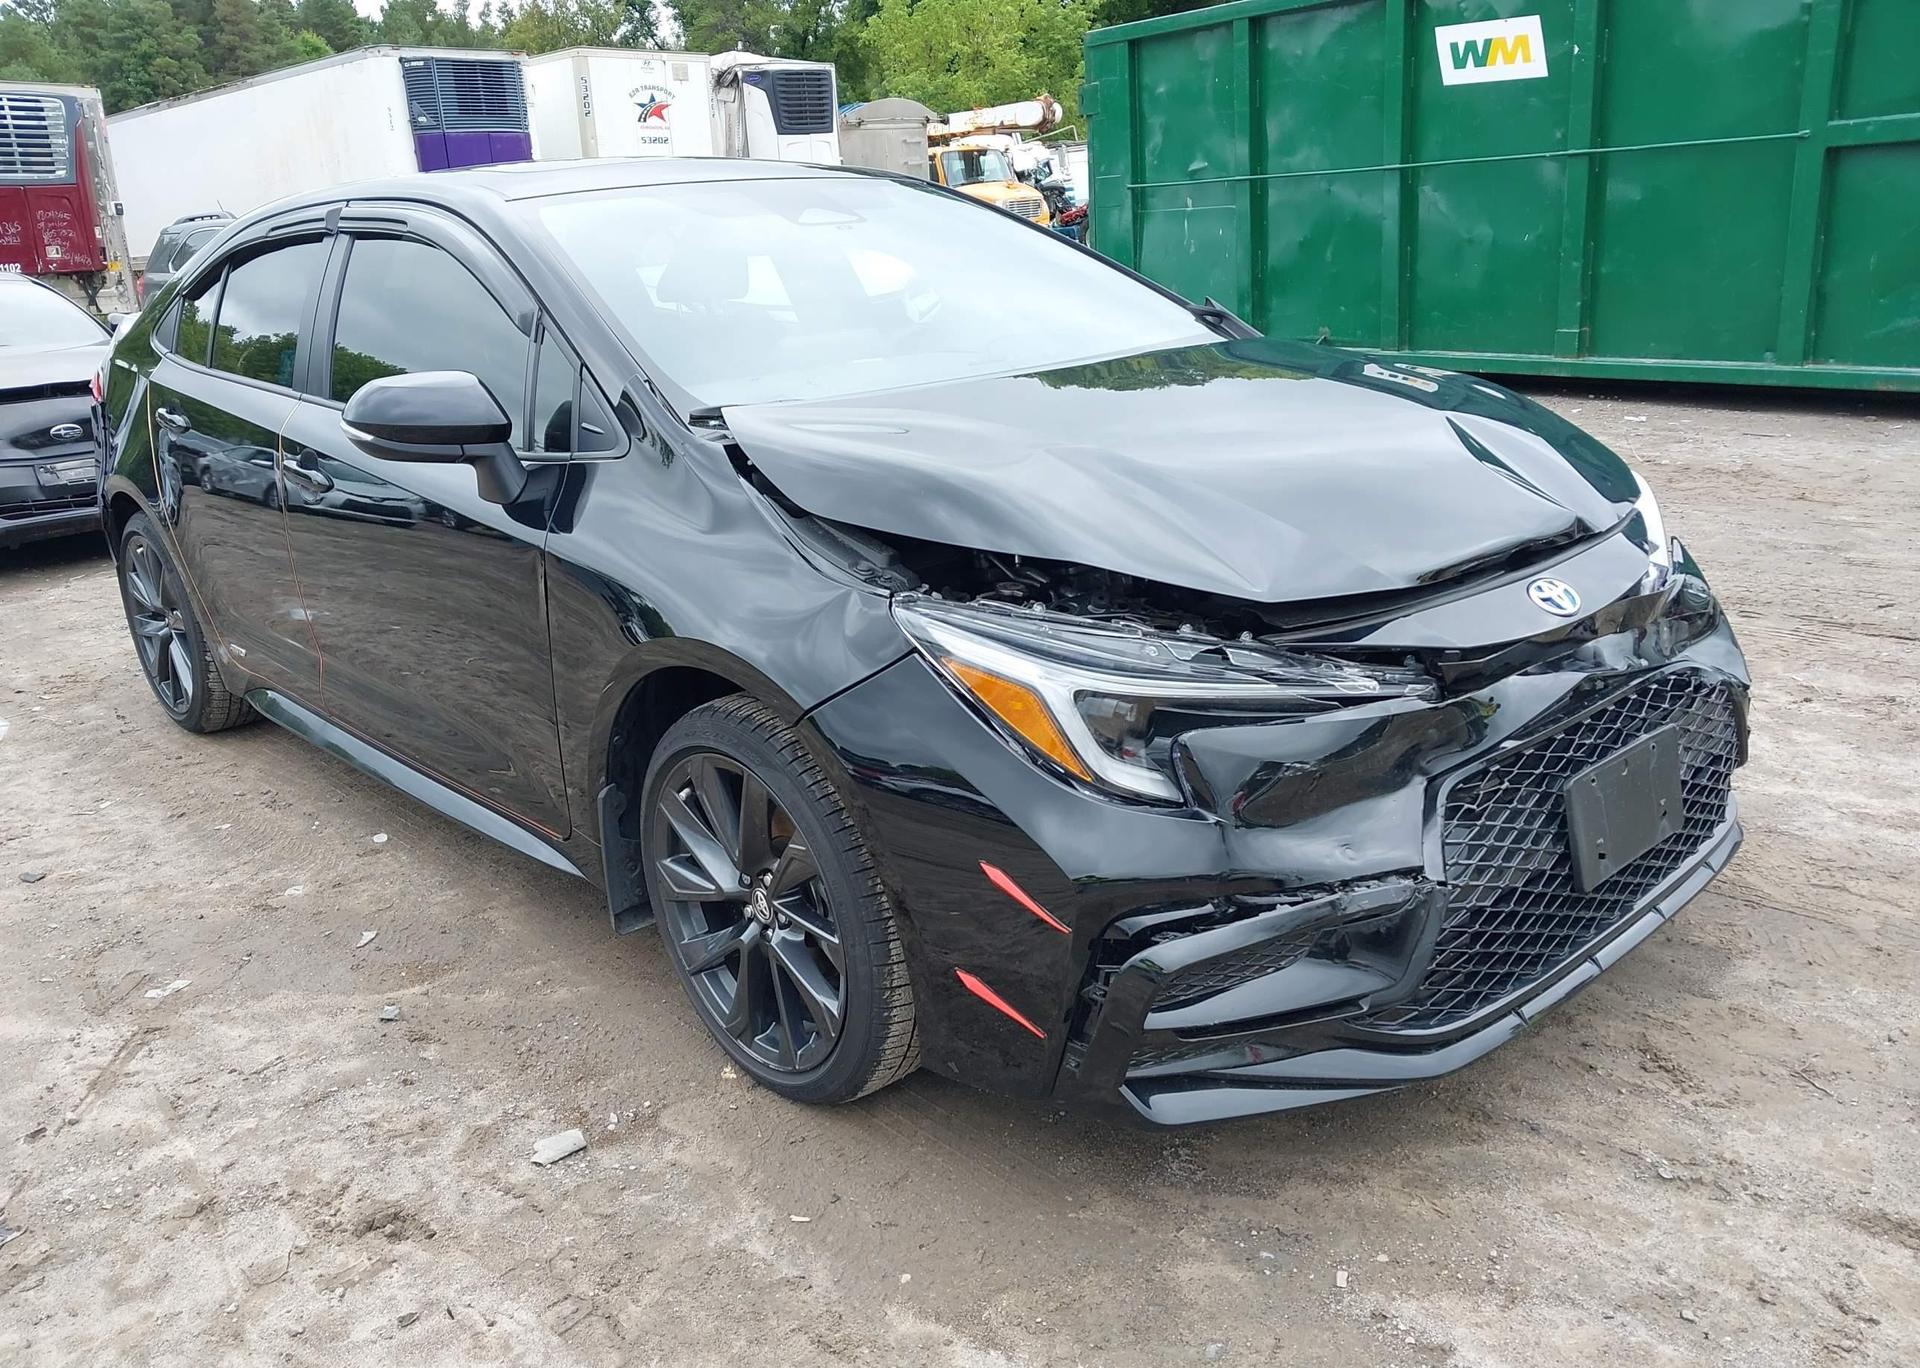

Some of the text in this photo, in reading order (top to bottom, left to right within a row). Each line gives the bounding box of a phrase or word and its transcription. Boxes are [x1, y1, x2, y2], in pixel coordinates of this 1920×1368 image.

[1450, 34, 1532, 69] WM
[580, 76, 591, 118] 53202
[640, 84, 676, 100] TRANSPORT
[641, 136, 670, 144] 53202
